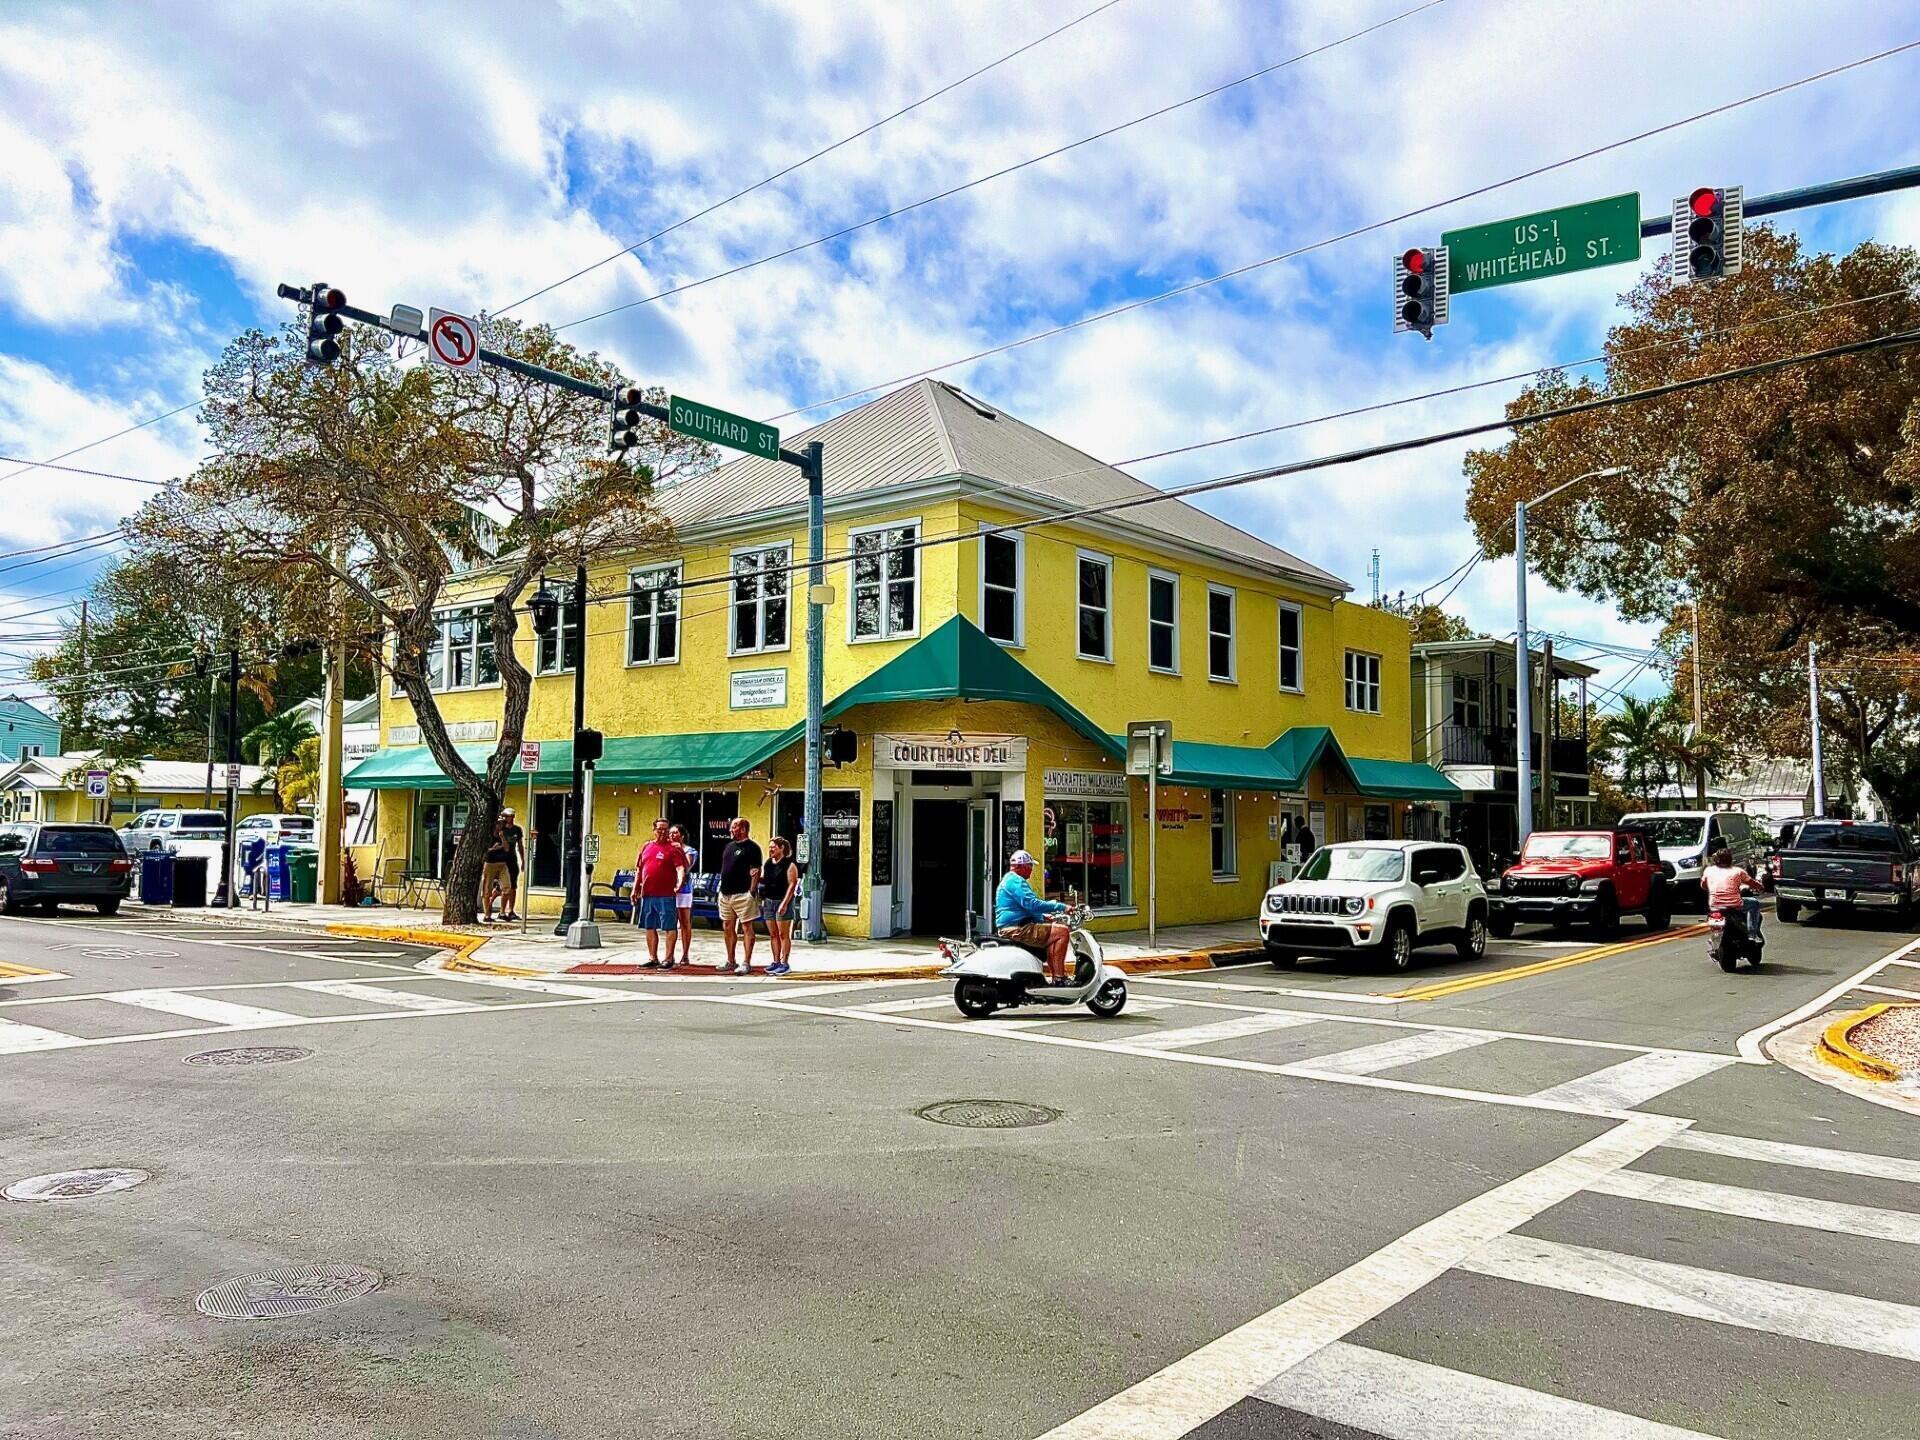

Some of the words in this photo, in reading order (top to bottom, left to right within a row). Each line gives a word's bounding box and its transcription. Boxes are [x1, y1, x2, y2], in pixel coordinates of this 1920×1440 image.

[1515, 219, 1558, 245] US-1
[1466, 247, 1567, 282] WHITEHEAD
[1586, 237, 1613, 259] ST.
[675, 406, 748, 444] SOUTHARD
[759, 432, 775, 452] ST.
[392, 730, 417, 740] ISLAND
[480, 726, 493, 735] SPA
[894, 745, 980, 764] COURTHOUSE
[984, 747, 1008, 763] DELI
[1044, 771, 1087, 787] HANDCRAFTED
[1088, 773, 1125, 789] MILKSHAKES
